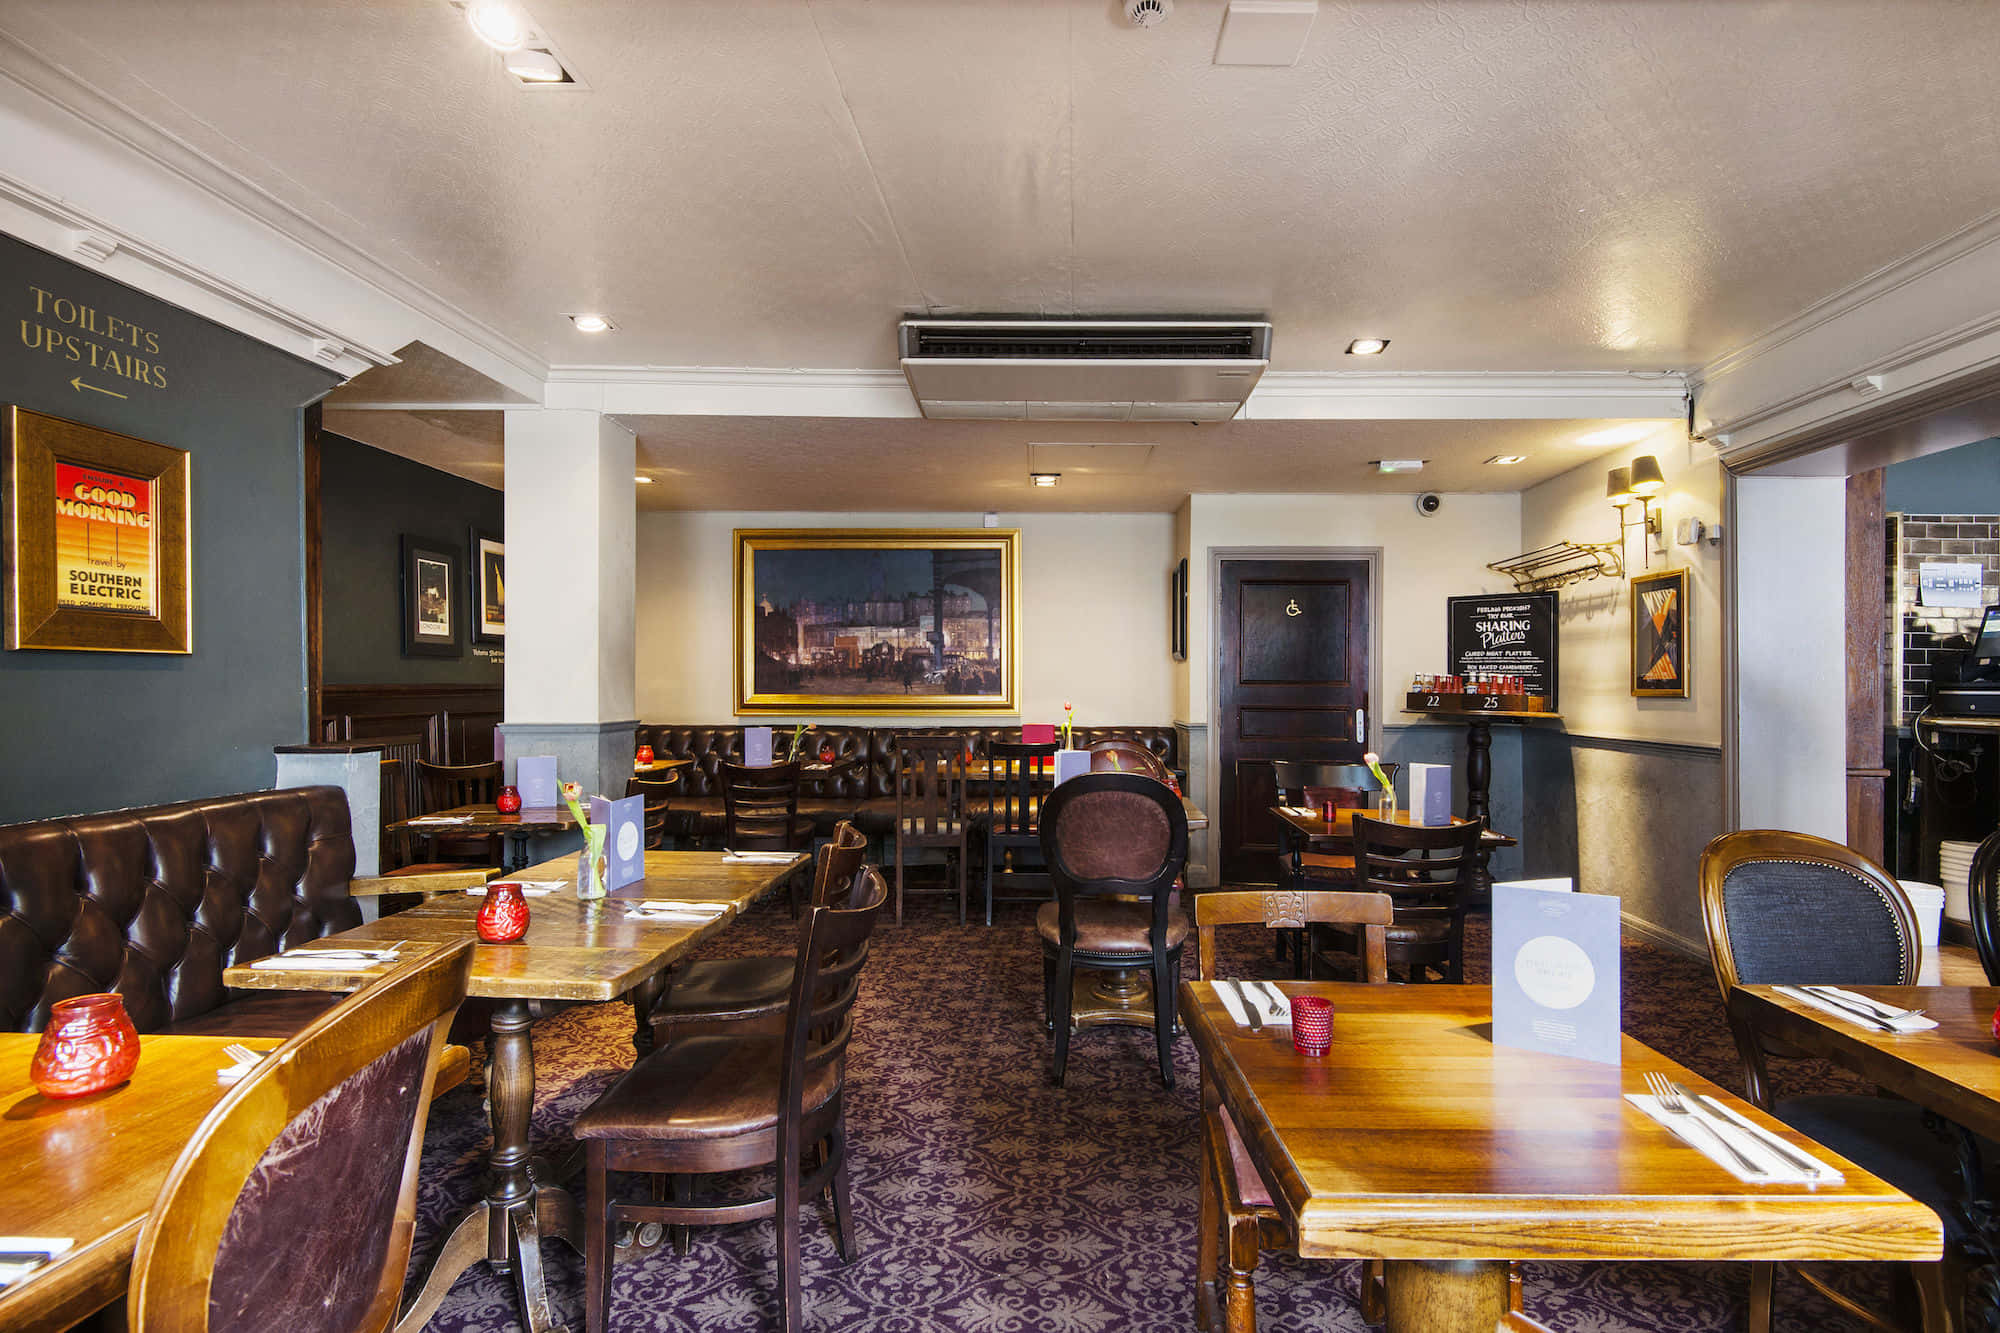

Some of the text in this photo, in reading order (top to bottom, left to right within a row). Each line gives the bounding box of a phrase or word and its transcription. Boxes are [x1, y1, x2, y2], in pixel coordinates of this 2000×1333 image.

[30, 286, 159, 354] TOILETS
[20, 319, 168, 389] UPSTAIRS
[73, 482, 136, 508] GOOD
[56, 497, 151, 528] MORNING
[69, 569, 142, 588] SOUTHERN
[70, 583, 142, 600] ELECTRIC
[1475, 619, 1531, 633] SHARING
[1479, 630, 1526, 648] Platters
[1426, 695, 1440, 707] 22
[1483, 697, 1498, 708] 25
